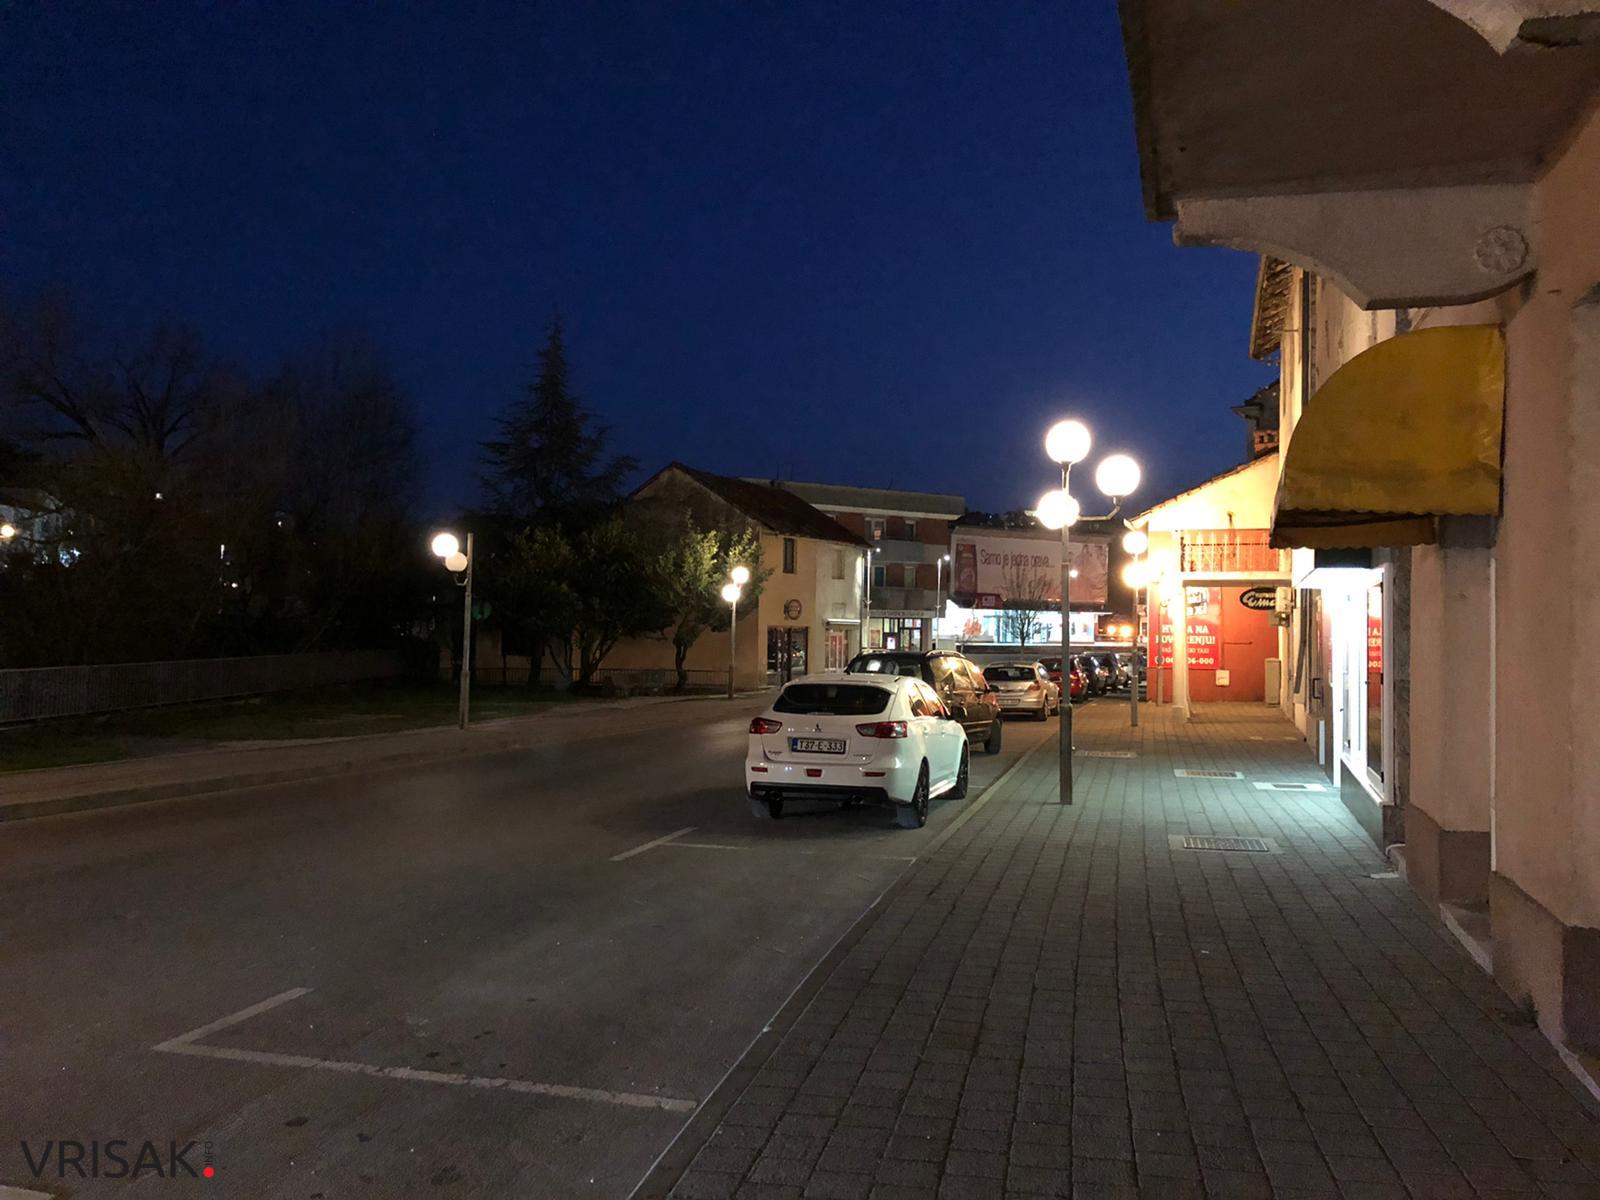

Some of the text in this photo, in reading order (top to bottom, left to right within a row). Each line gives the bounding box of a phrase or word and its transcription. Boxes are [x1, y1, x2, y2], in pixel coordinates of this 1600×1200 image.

[981, 549, 1001, 566] Samo
[1195, 625, 1208, 634] NA
[799, 741, 843, 751] T37-E-333
